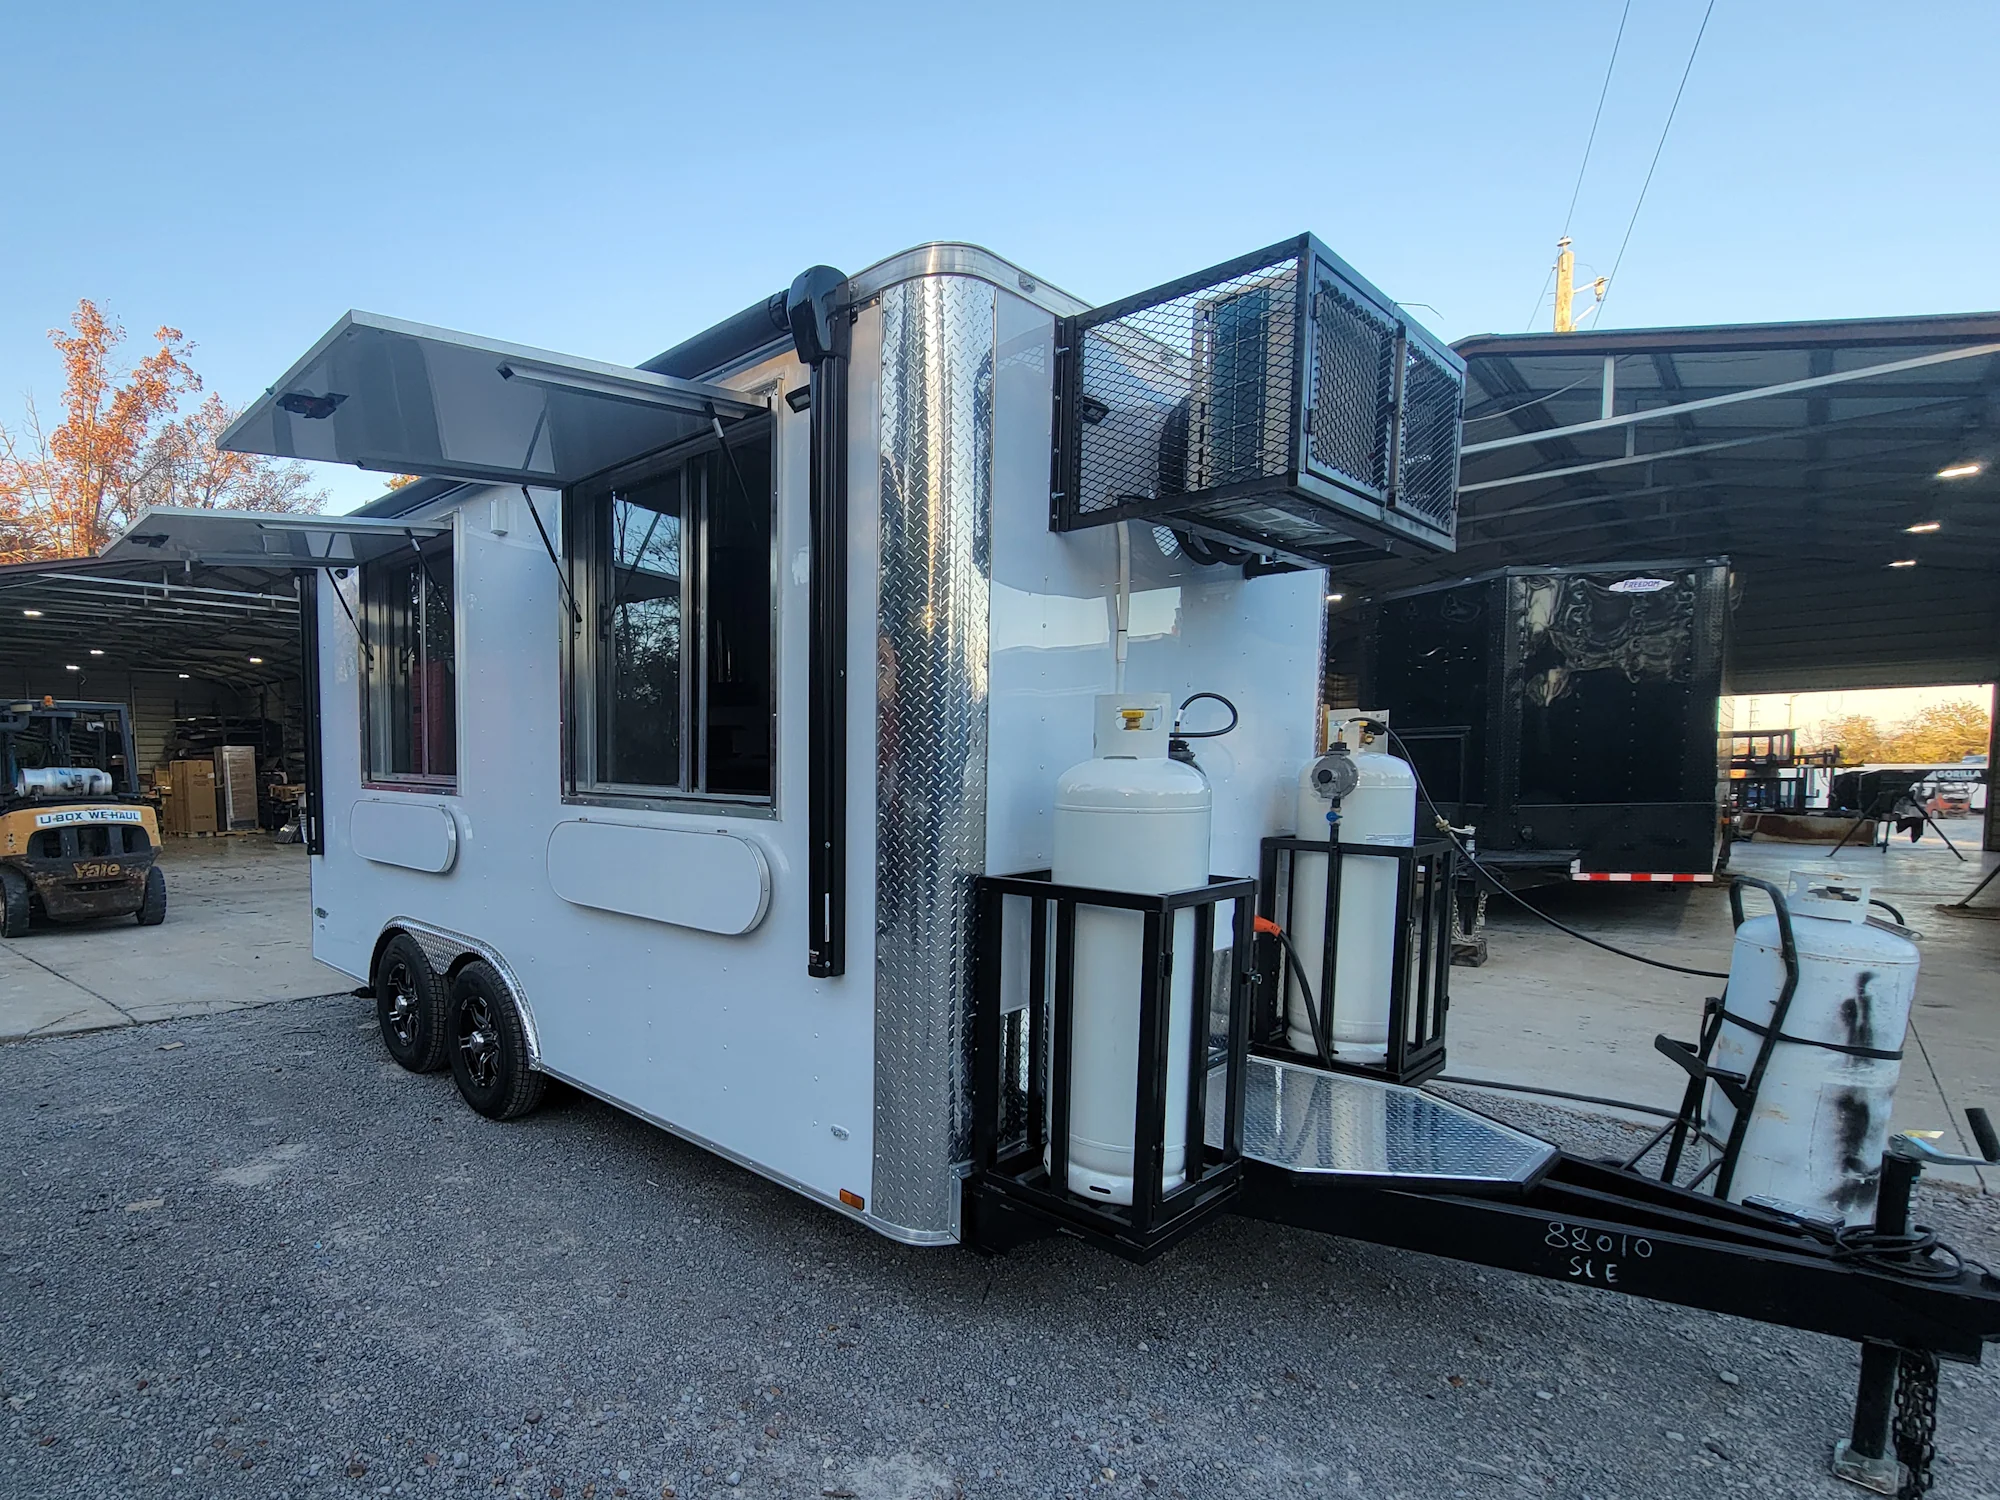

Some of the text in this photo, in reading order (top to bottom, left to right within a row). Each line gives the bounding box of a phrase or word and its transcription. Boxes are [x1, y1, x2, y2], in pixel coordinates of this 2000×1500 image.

[1623, 580, 1660, 589] FREEDOM
[1936, 770, 1982, 778] GORILLA
[40, 811, 139, 824] U-BOX WE-HAUL
[73, 862, 121, 879] Yale
[1544, 1221, 1653, 1258] 88010
